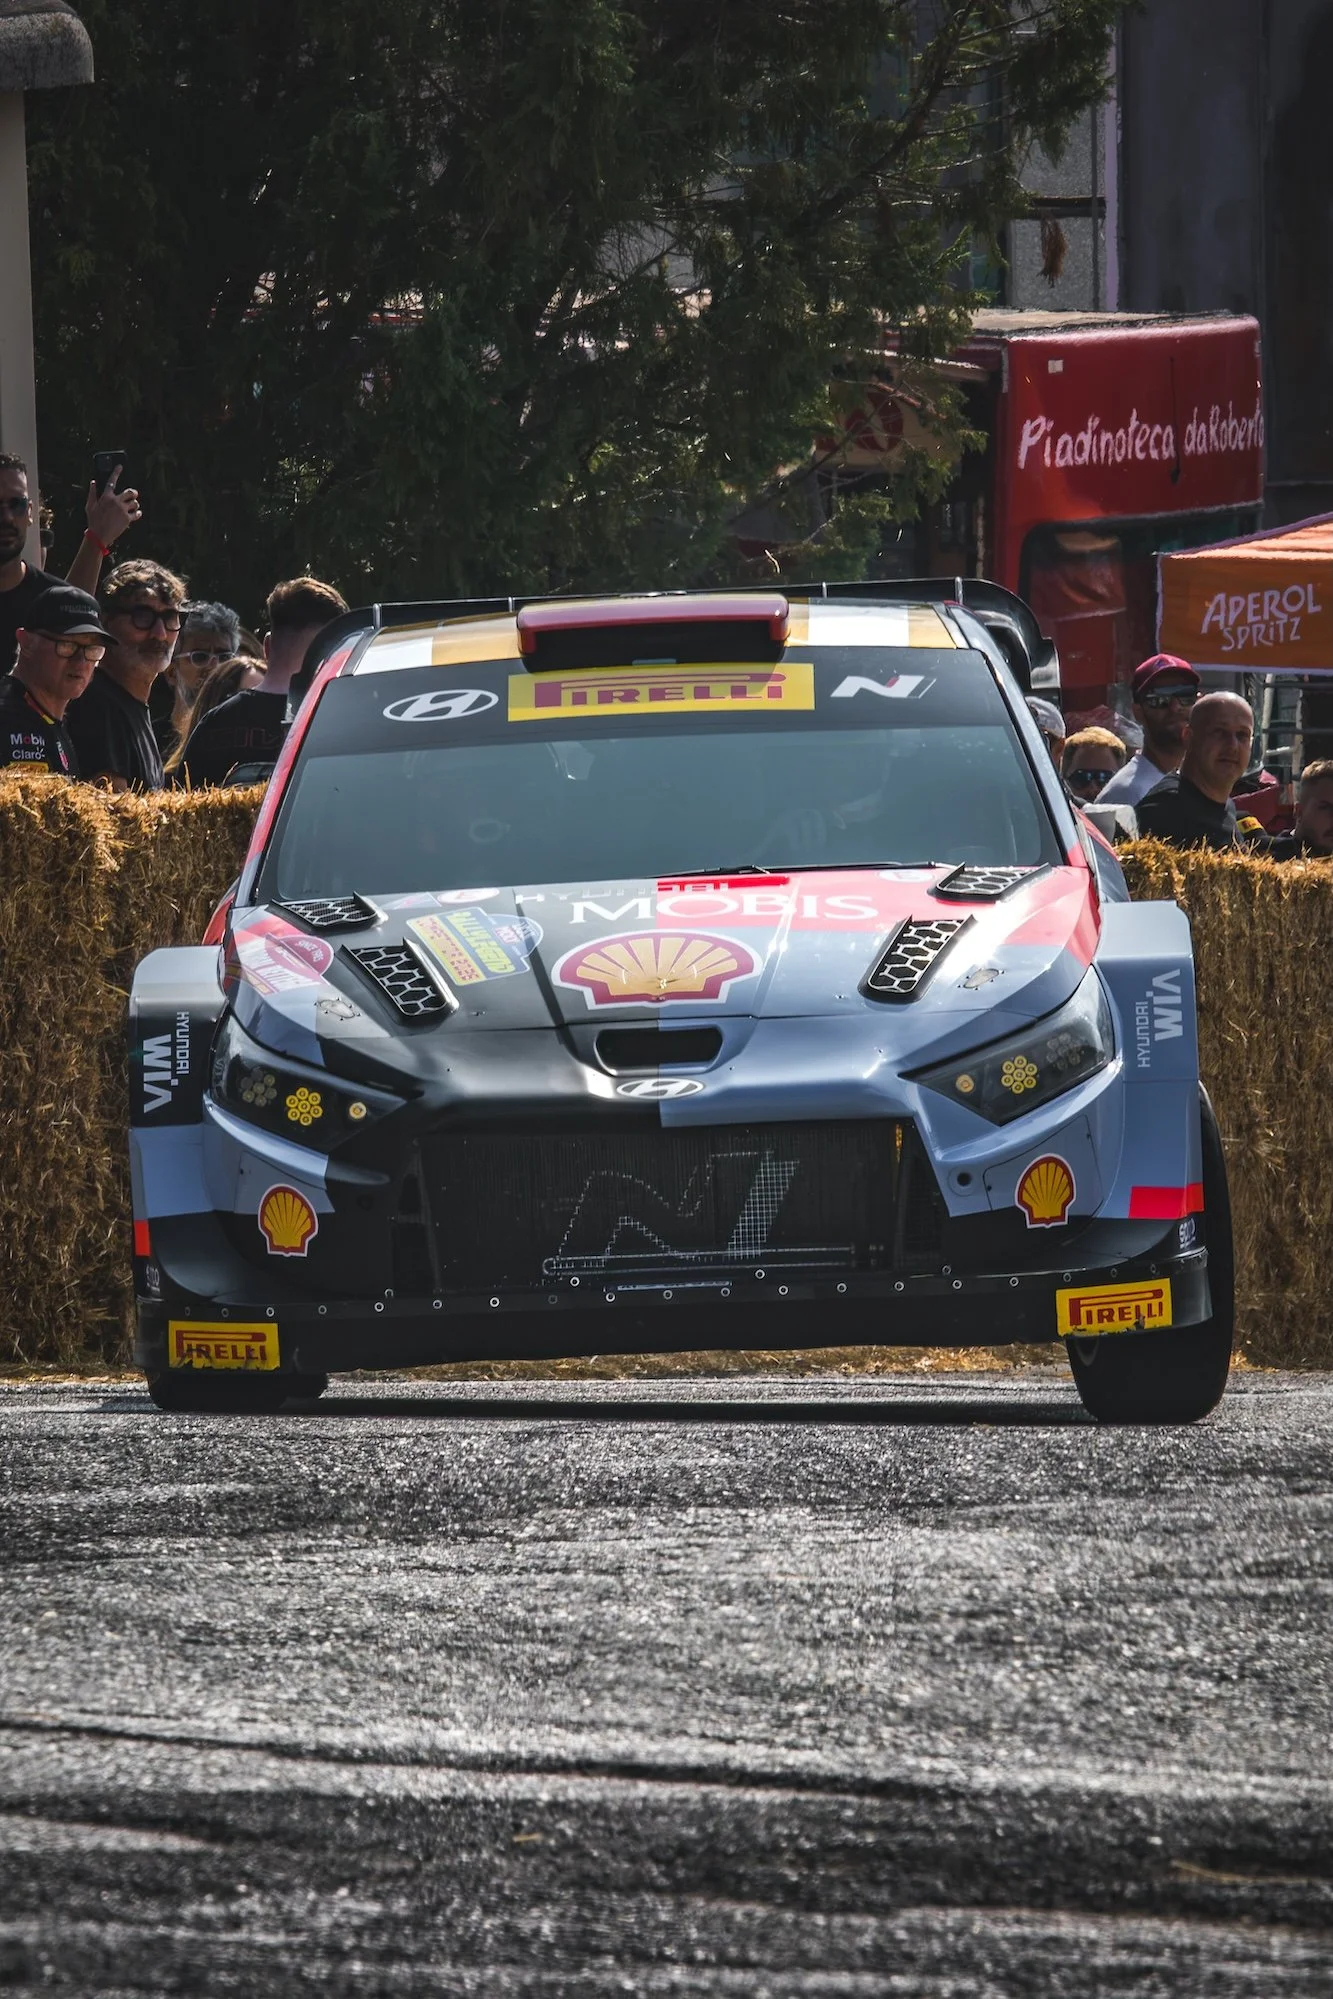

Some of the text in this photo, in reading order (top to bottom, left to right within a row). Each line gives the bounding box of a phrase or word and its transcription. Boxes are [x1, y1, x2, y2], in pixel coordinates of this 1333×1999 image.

[1018, 408, 1176, 469] Piadinoteca
[1201, 583, 1323, 634] APEROL
[534, 672, 788, 708] PIRELLI
[569, 893, 879, 925] MOBIS
[1145, 968, 1183, 1042] WIA
[175, 1011, 190, 1075] HYUNDAI
[1135, 1001, 1151, 1069] HYUNDAI
[142, 1033, 179, 1114] WIA
[1068, 1288, 1164, 1327] PIRELLI
[175, 1330, 267, 1361] PIRELLI
